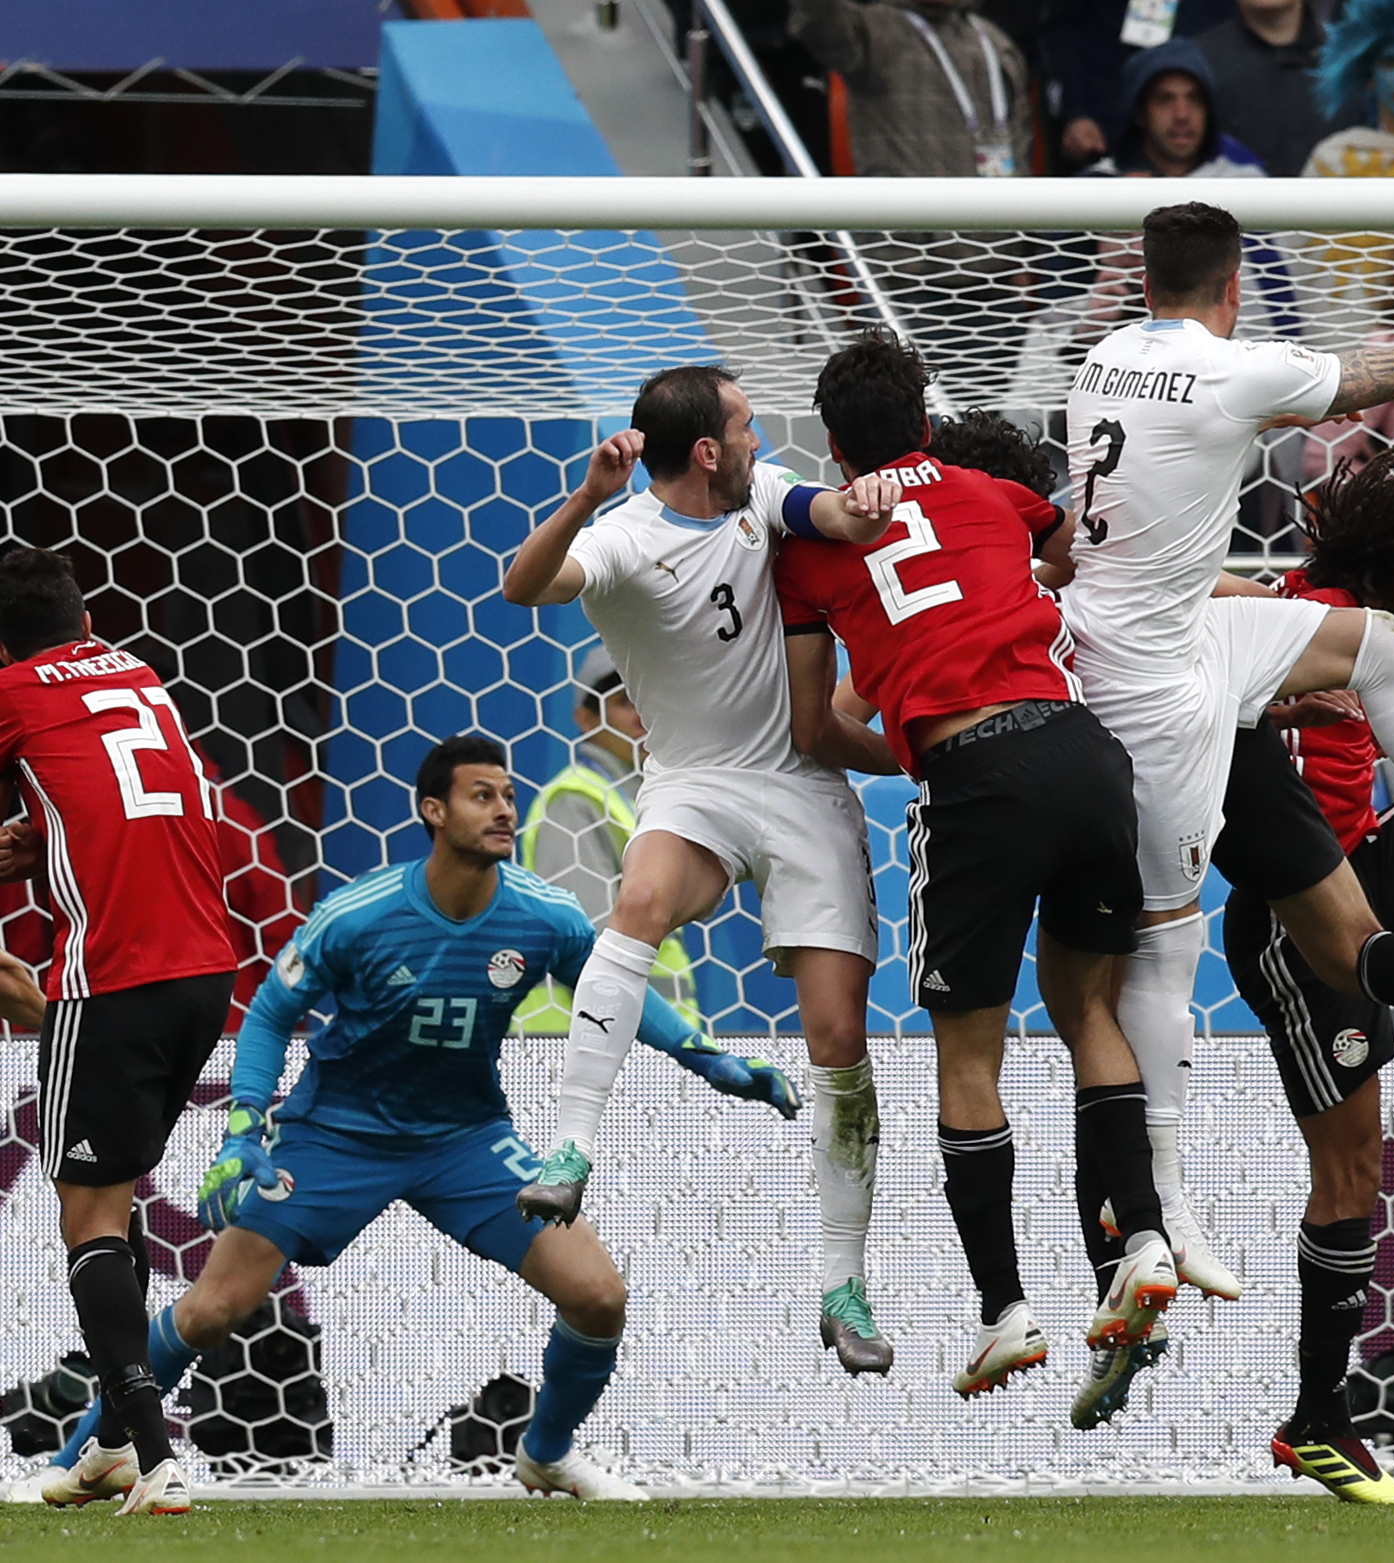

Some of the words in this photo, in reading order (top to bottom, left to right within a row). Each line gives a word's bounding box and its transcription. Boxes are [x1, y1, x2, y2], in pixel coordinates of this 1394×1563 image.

[1082, 417, 1127, 546] 2
[710, 582, 743, 643] 3
[863, 499, 965, 627] 2
[81, 685, 214, 821] 21
[408, 997, 477, 1049] 23
